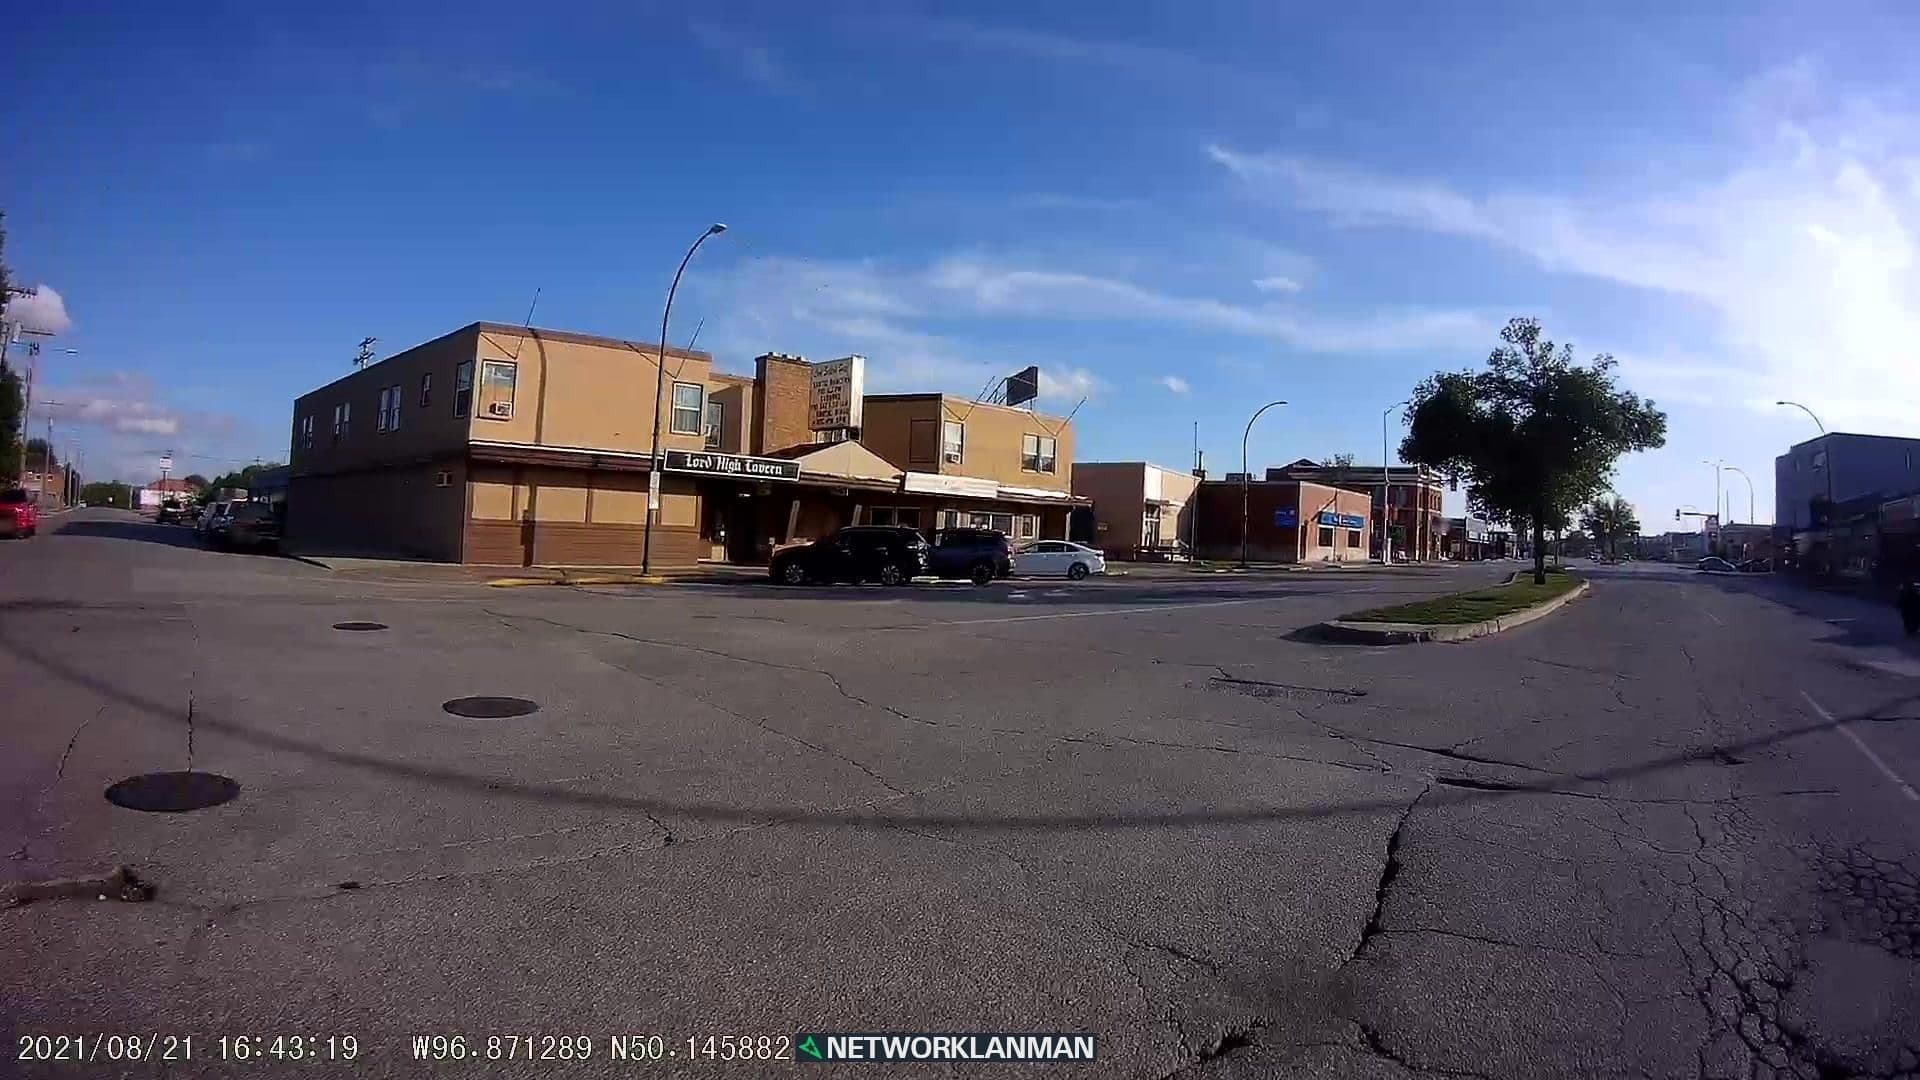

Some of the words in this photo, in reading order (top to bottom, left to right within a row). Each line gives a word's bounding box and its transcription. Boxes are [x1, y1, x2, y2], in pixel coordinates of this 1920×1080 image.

[684, 453, 712, 468] Lord
[715, 455, 742, 473] High
[744, 459, 783, 475] Tavern
